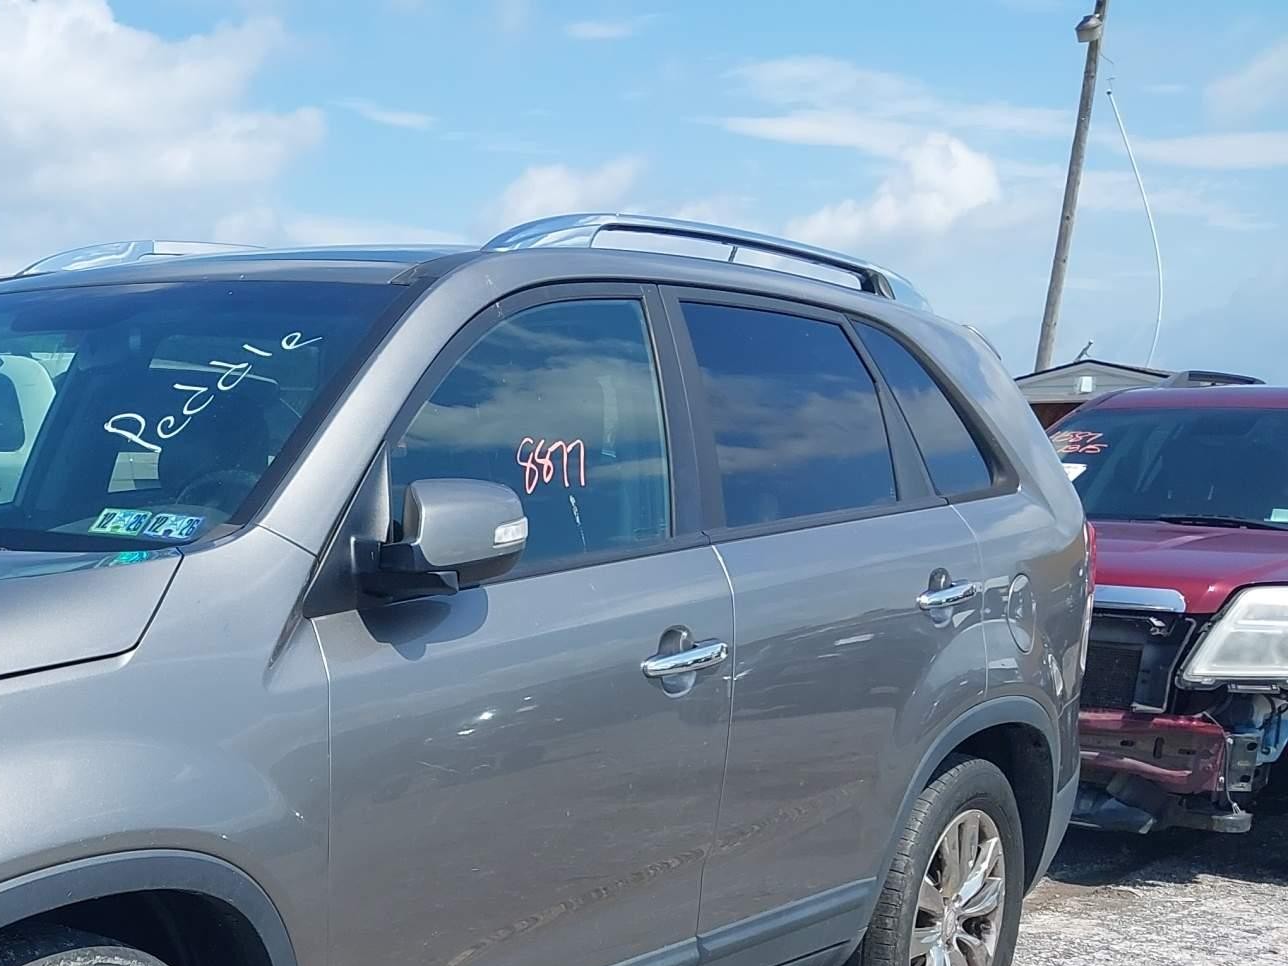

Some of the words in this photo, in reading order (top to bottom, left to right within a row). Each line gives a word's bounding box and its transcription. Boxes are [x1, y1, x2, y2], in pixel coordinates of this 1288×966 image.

[517, 437, 585, 494] 8877
[96, 512, 117, 529] 12
[127, 514, 147, 532] 26
[148, 516, 169, 533] 12
